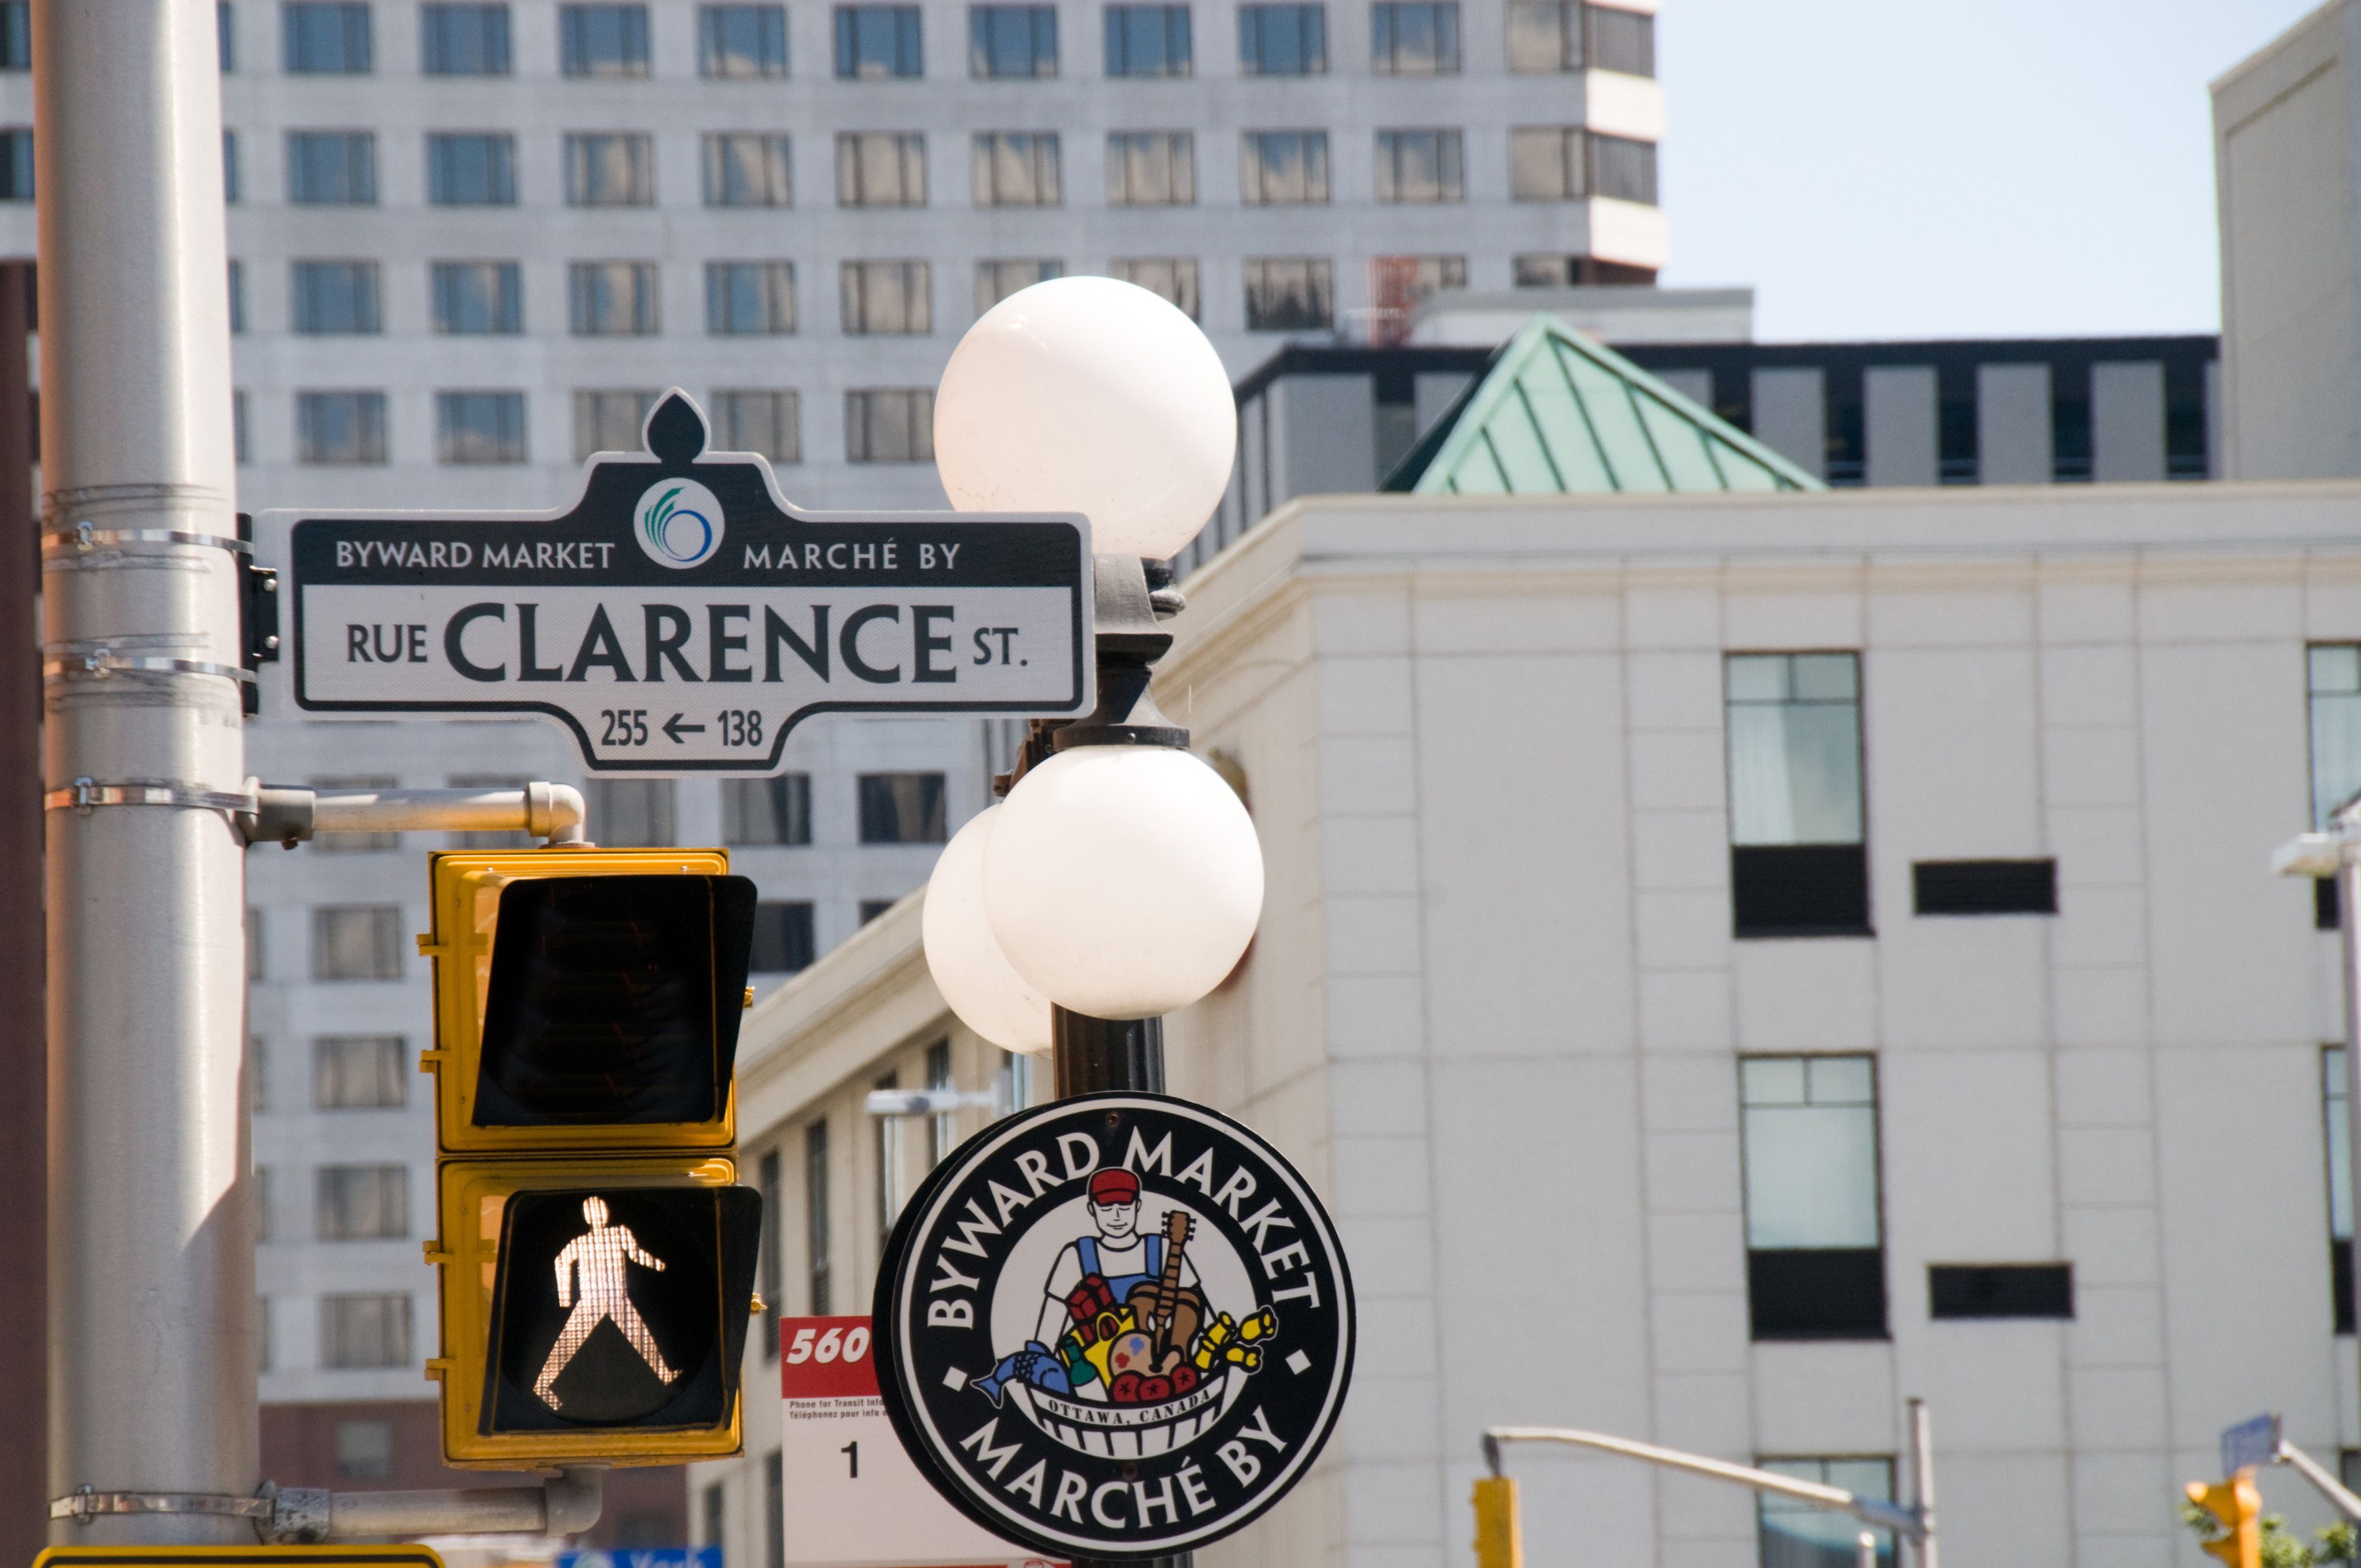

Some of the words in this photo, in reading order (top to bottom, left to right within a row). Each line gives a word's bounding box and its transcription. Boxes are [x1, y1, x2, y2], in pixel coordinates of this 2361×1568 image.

[336, 540, 473, 569] BYWARD
[482, 542, 615, 570] MARKET
[743, 537, 898, 570] MARCHÉ
[919, 543, 960, 570] BY
[347, 624, 428, 663] RUE
[443, 602, 958, 684] CLARENCE
[973, 627, 1028, 667] ST.
[601, 709, 649, 746] 255
[717, 709, 763, 747] 138
[927, 1132, 1100, 1329] BYWARD
[1123, 1125, 1320, 1309] MARKET
[786, 1326, 870, 1365] 560
[790, 1400, 816, 1409] Phone
[835, 1398, 864, 1407] Transit
[790, 1409, 837, 1419] Téléphonez
[840, 1411, 859, 1419] pour
[1048, 1399, 1131, 1425] OTTAWA,
[1138, 1389, 1210, 1423] CANADA
[841, 1440, 858, 1479] 1
[960, 1417, 1217, 1529] MARCHÉ
[1215, 1405, 1287, 1488] BY
